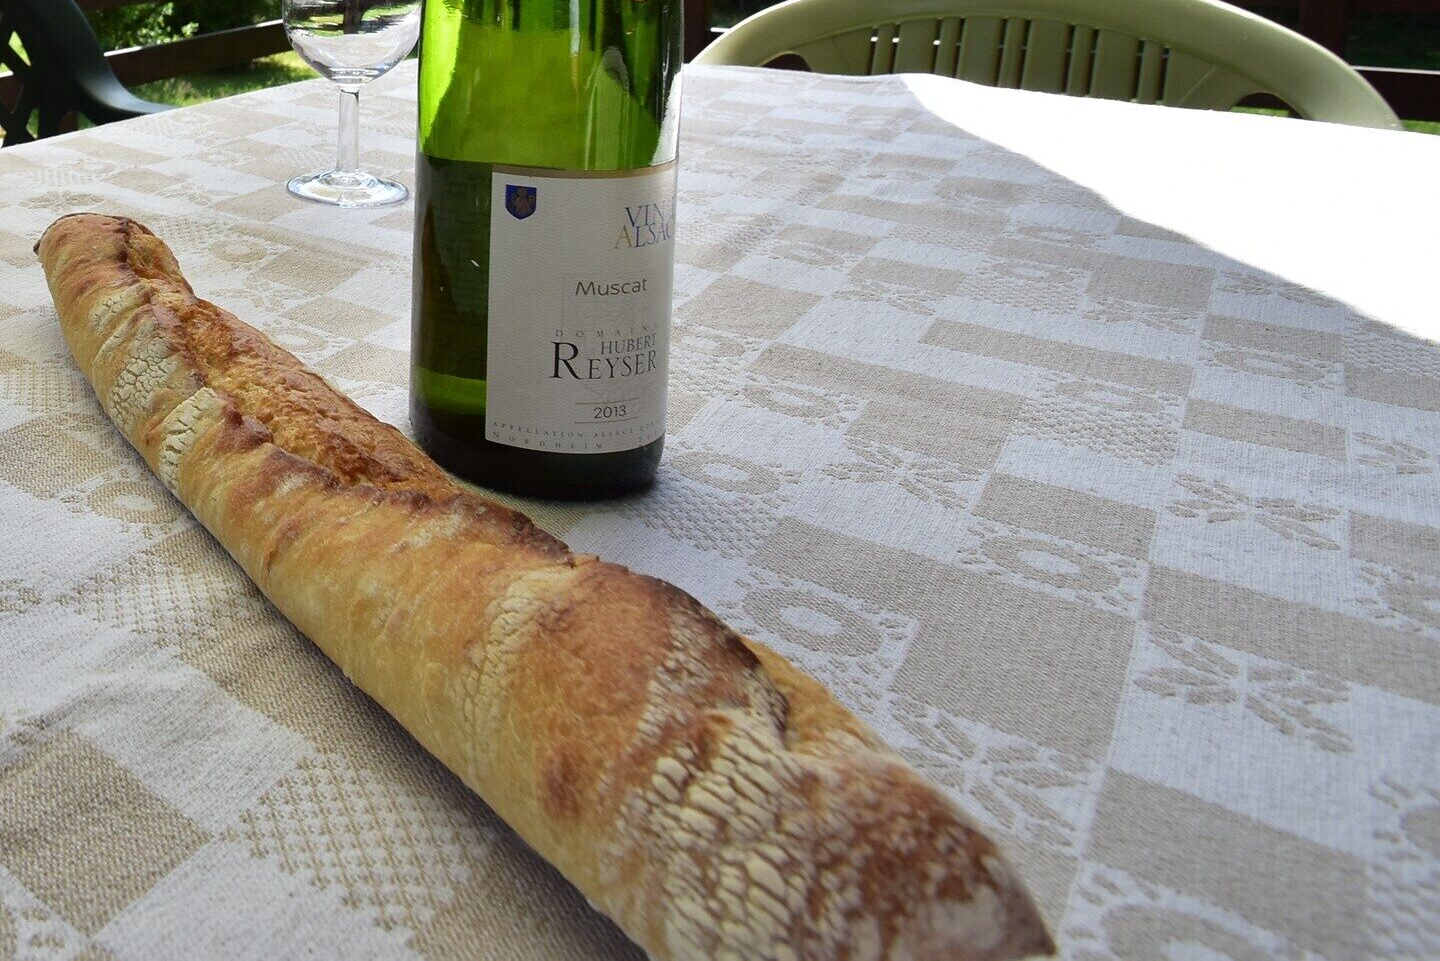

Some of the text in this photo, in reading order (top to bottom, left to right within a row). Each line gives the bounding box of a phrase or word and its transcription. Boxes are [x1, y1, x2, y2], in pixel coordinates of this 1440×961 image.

[575, 278, 647, 296] Muscat
[601, 332, 657, 355] HUBERT
[549, 341, 657, 380] REYSER
[593, 404, 627, 419] 2013
